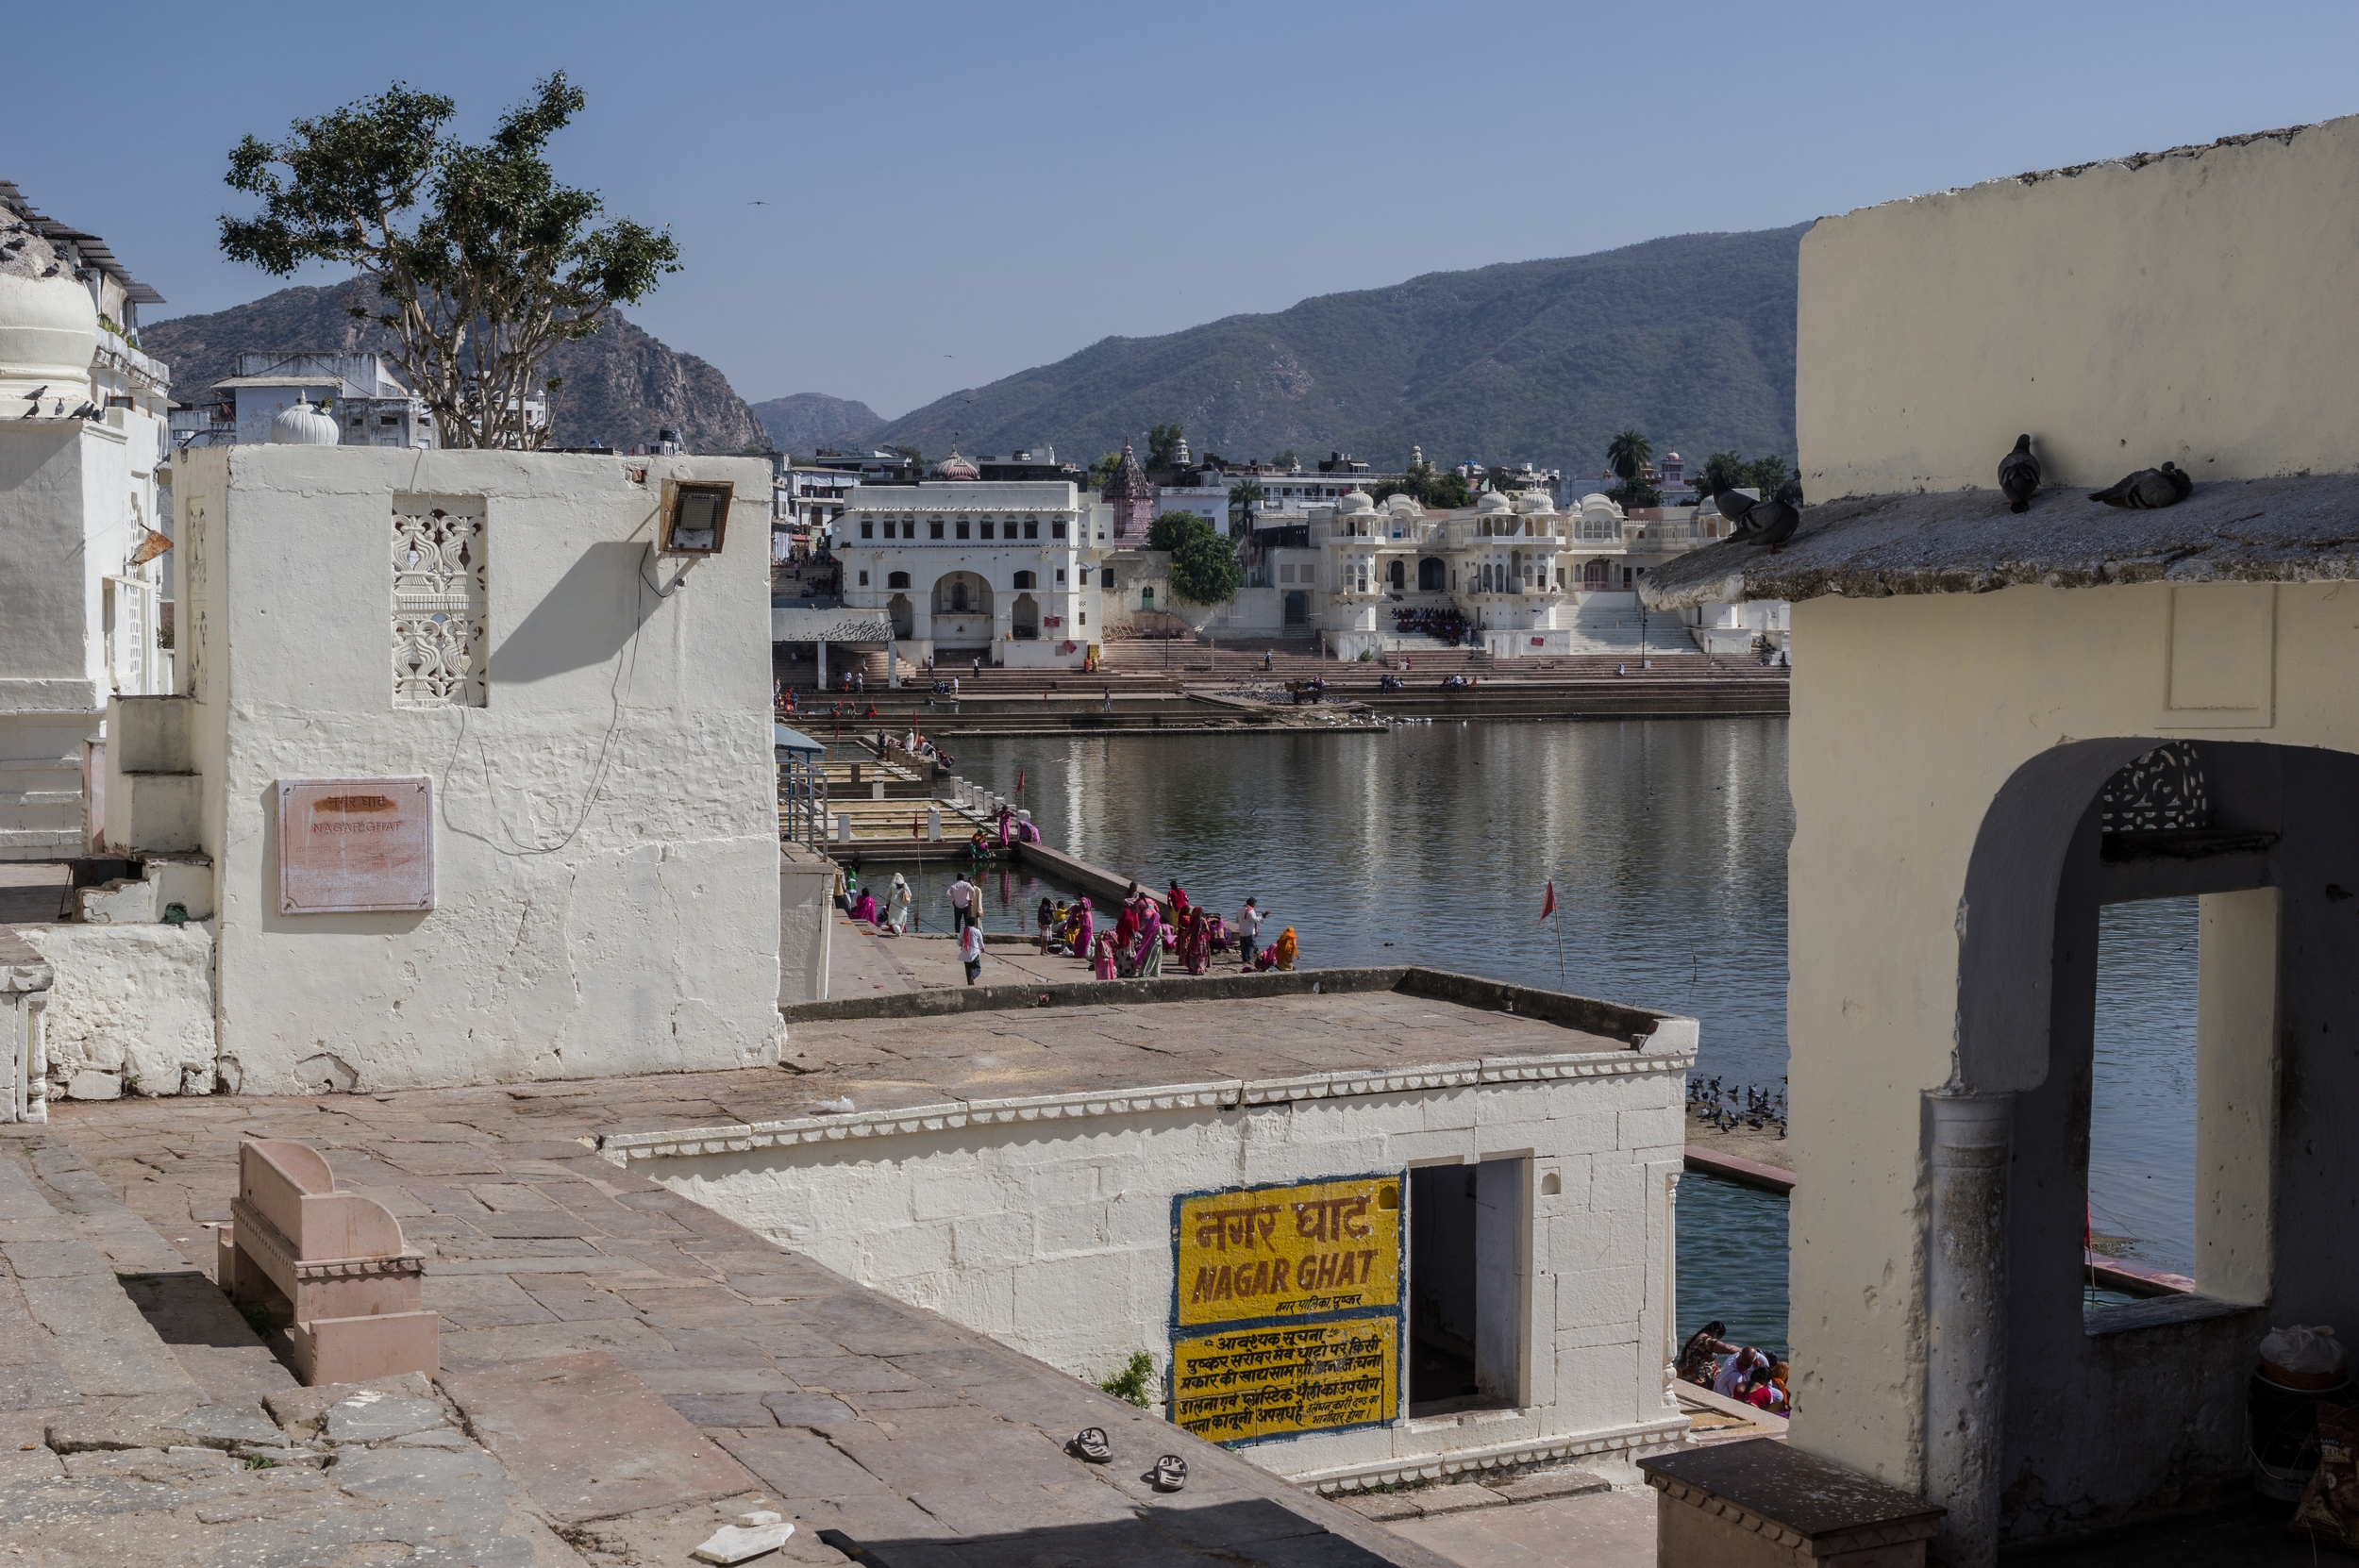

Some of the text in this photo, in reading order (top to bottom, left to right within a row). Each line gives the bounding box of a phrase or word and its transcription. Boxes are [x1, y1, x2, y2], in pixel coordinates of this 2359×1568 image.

[327, 794, 386, 809] नगर घाट
[312, 820, 401, 834] NAGAR GHAT
[1196, 1194, 1371, 1253] नगर घाट
[1191, 1249, 1379, 1304] NAGAR GHAT
[1276, 1301, 1297, 1313] नगर
[1332, 1293, 1363, 1309] पुष्कर
[1216, 1327, 1327, 1351] आवश्यक सूचना
[1186, 1356, 1229, 1375] पुष्कर
[1230, 1346, 1272, 1367] सरोवर
[1330, 1341, 1349, 1357] पर
[1349, 1334, 1382, 1354] किसी
[1180, 1374, 1220, 1390] प्रकार
[1220, 1369, 1238, 1385] की
[1239, 1367, 1269, 1383] खाद्य
[1356, 1353, 1381, 1369] चना
[1179, 1397, 1218, 1417] डालना
[1296, 1379, 1322, 1401] थैली
[1322, 1382, 1338, 1396] का
[1338, 1375, 1380, 1395] उपयोग
[1368, 1394, 1380, 1405] का
[1212, 1408, 1254, 1431] कानूनी
[1255, 1404, 1295, 1424] अपराध
